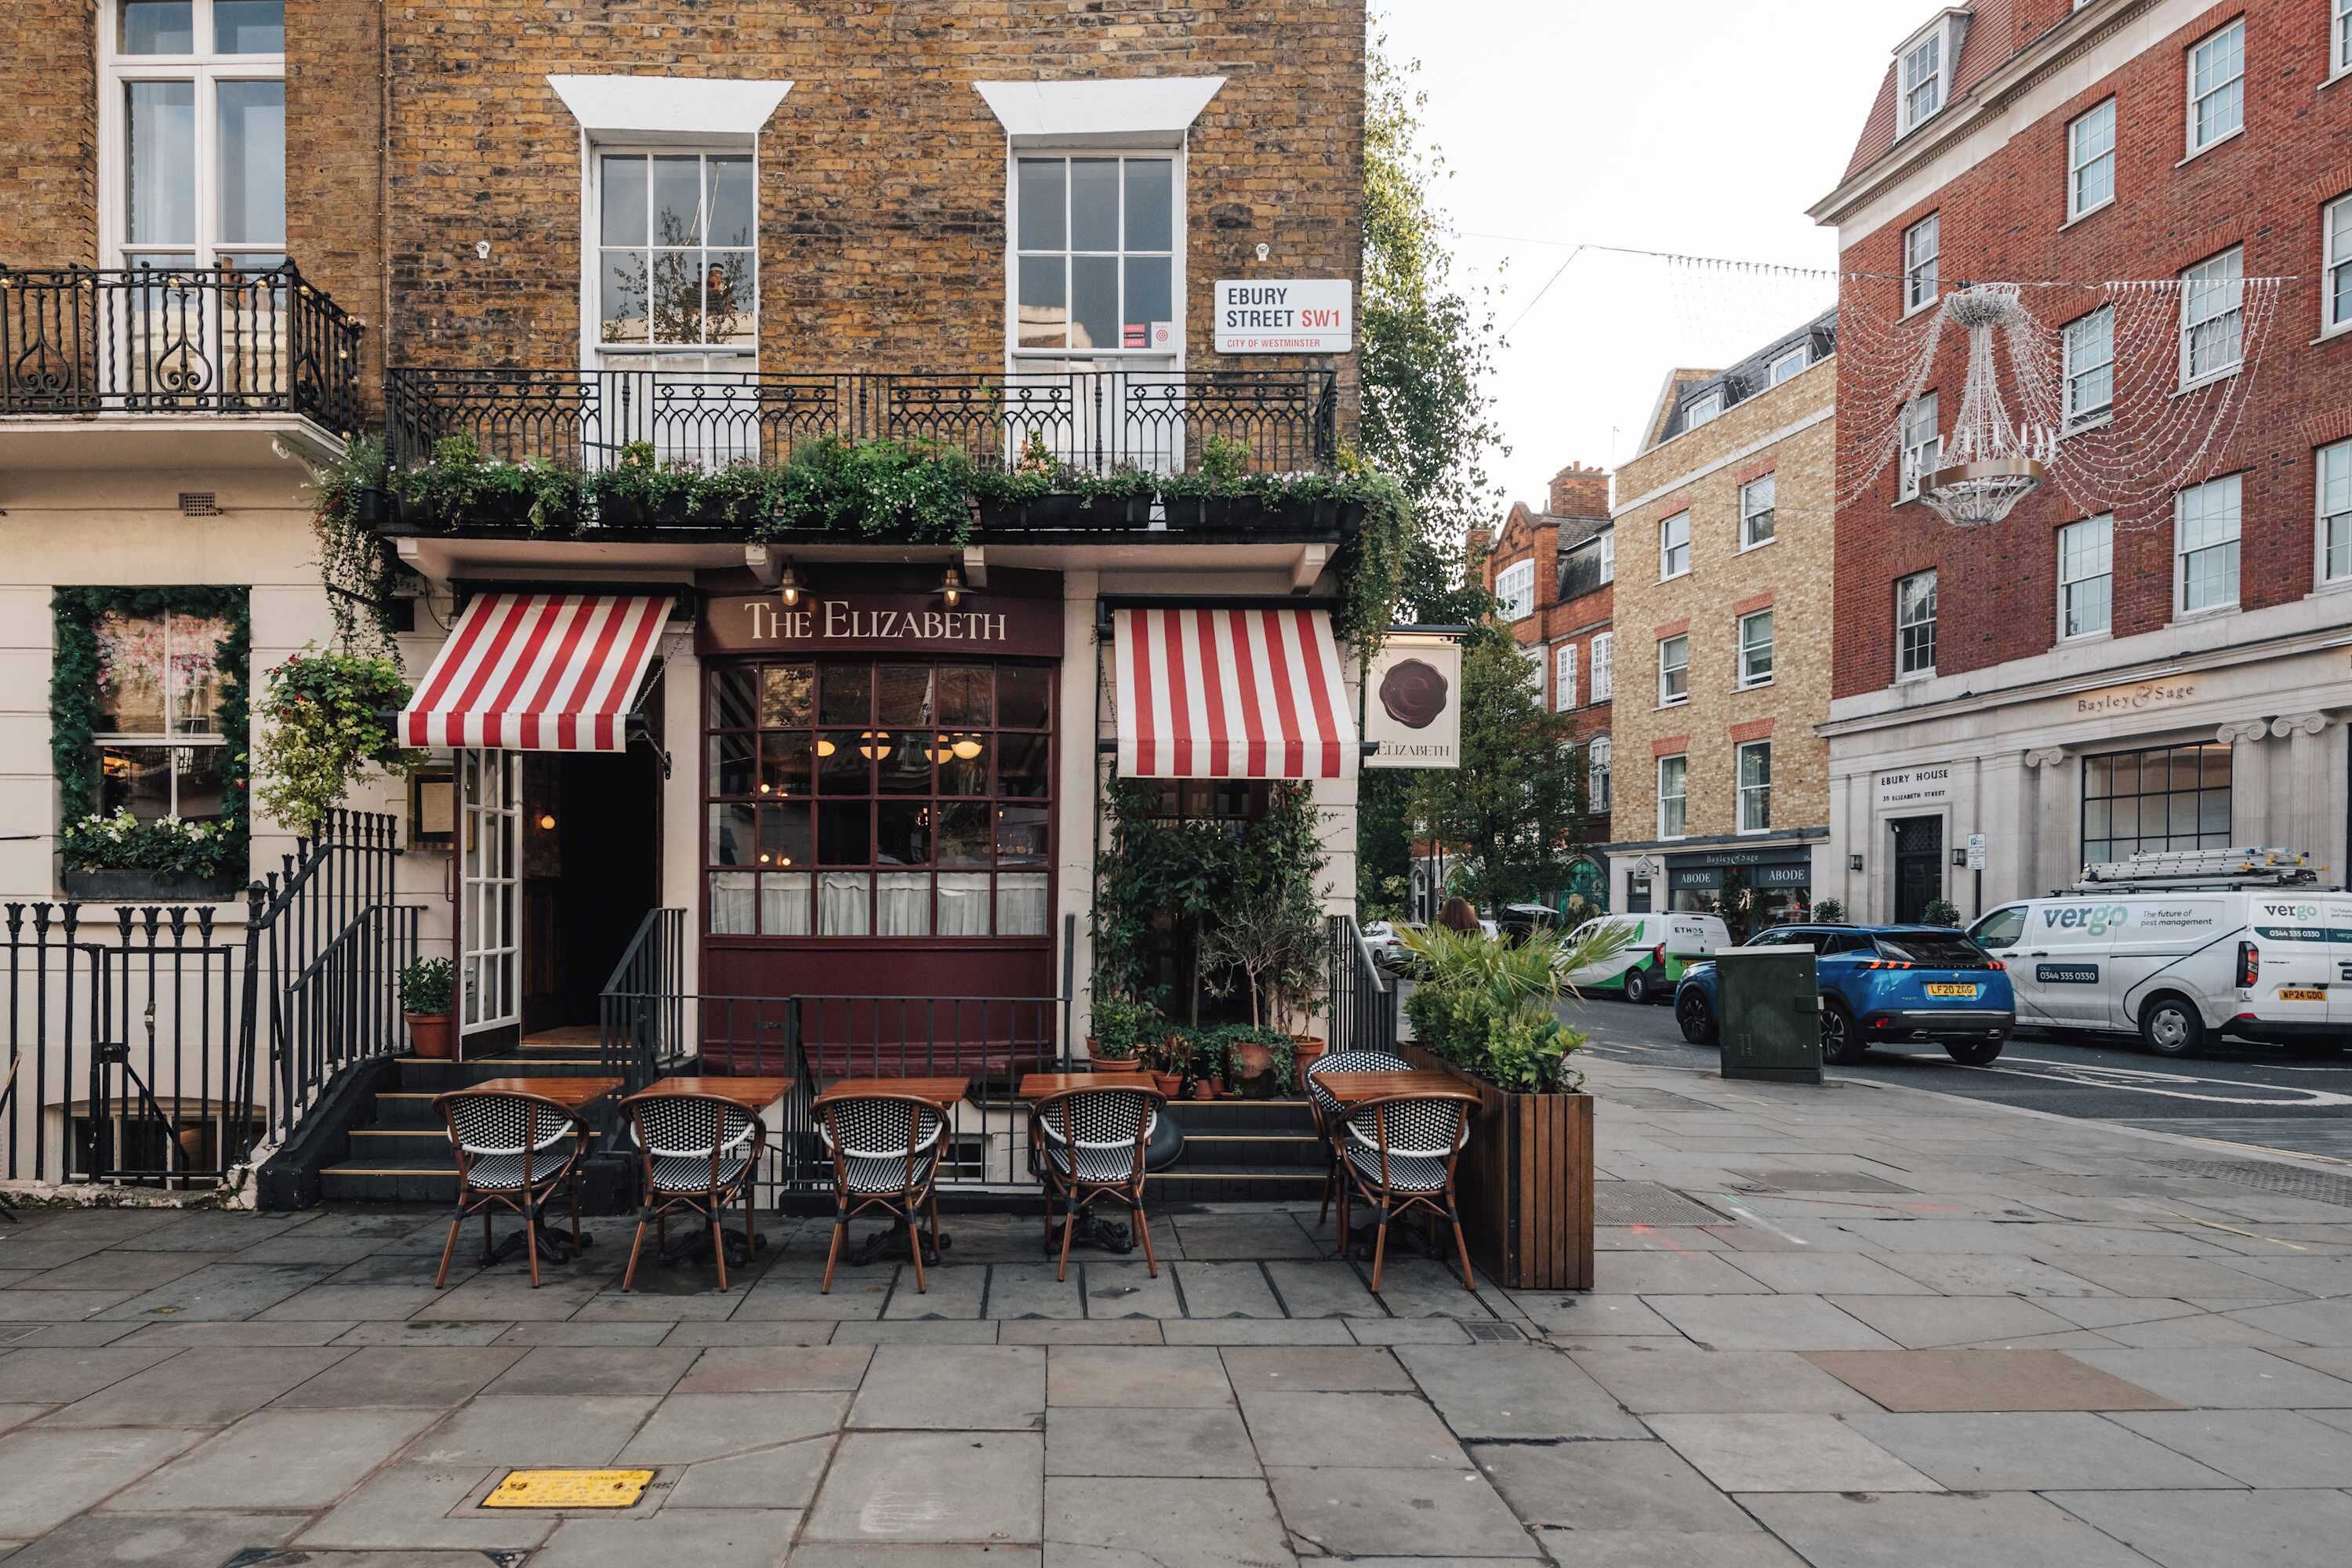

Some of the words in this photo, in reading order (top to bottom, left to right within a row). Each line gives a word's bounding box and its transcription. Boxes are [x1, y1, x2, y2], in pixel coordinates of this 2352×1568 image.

[1228, 288, 1287, 305] EBURY
[1227, 310, 1294, 328] STREET
[1301, 310, 1340, 328] SW1
[1227, 339, 1245, 348] CITY
[1248, 339, 1258, 348] OF
[1261, 339, 1320, 347] WESTMINSTER
[2078, 695, 2129, 712] Bayley
[2132, 684, 2154, 708] &
[2155, 686, 2195, 701] Sage
[1882, 774, 1910, 786] EBURY
[1916, 769, 1948, 782] HOUSE
[1892, 793, 1921, 801] ELIZABETH
[1681, 873, 1711, 884] ABODE
[1769, 869, 1806, 881] ABODE
[2183, 909, 2193, 917] of
[2264, 905, 2317, 921] vergo
[2044, 904, 2129, 937] vergo
[2158, 918, 2212, 927] management
